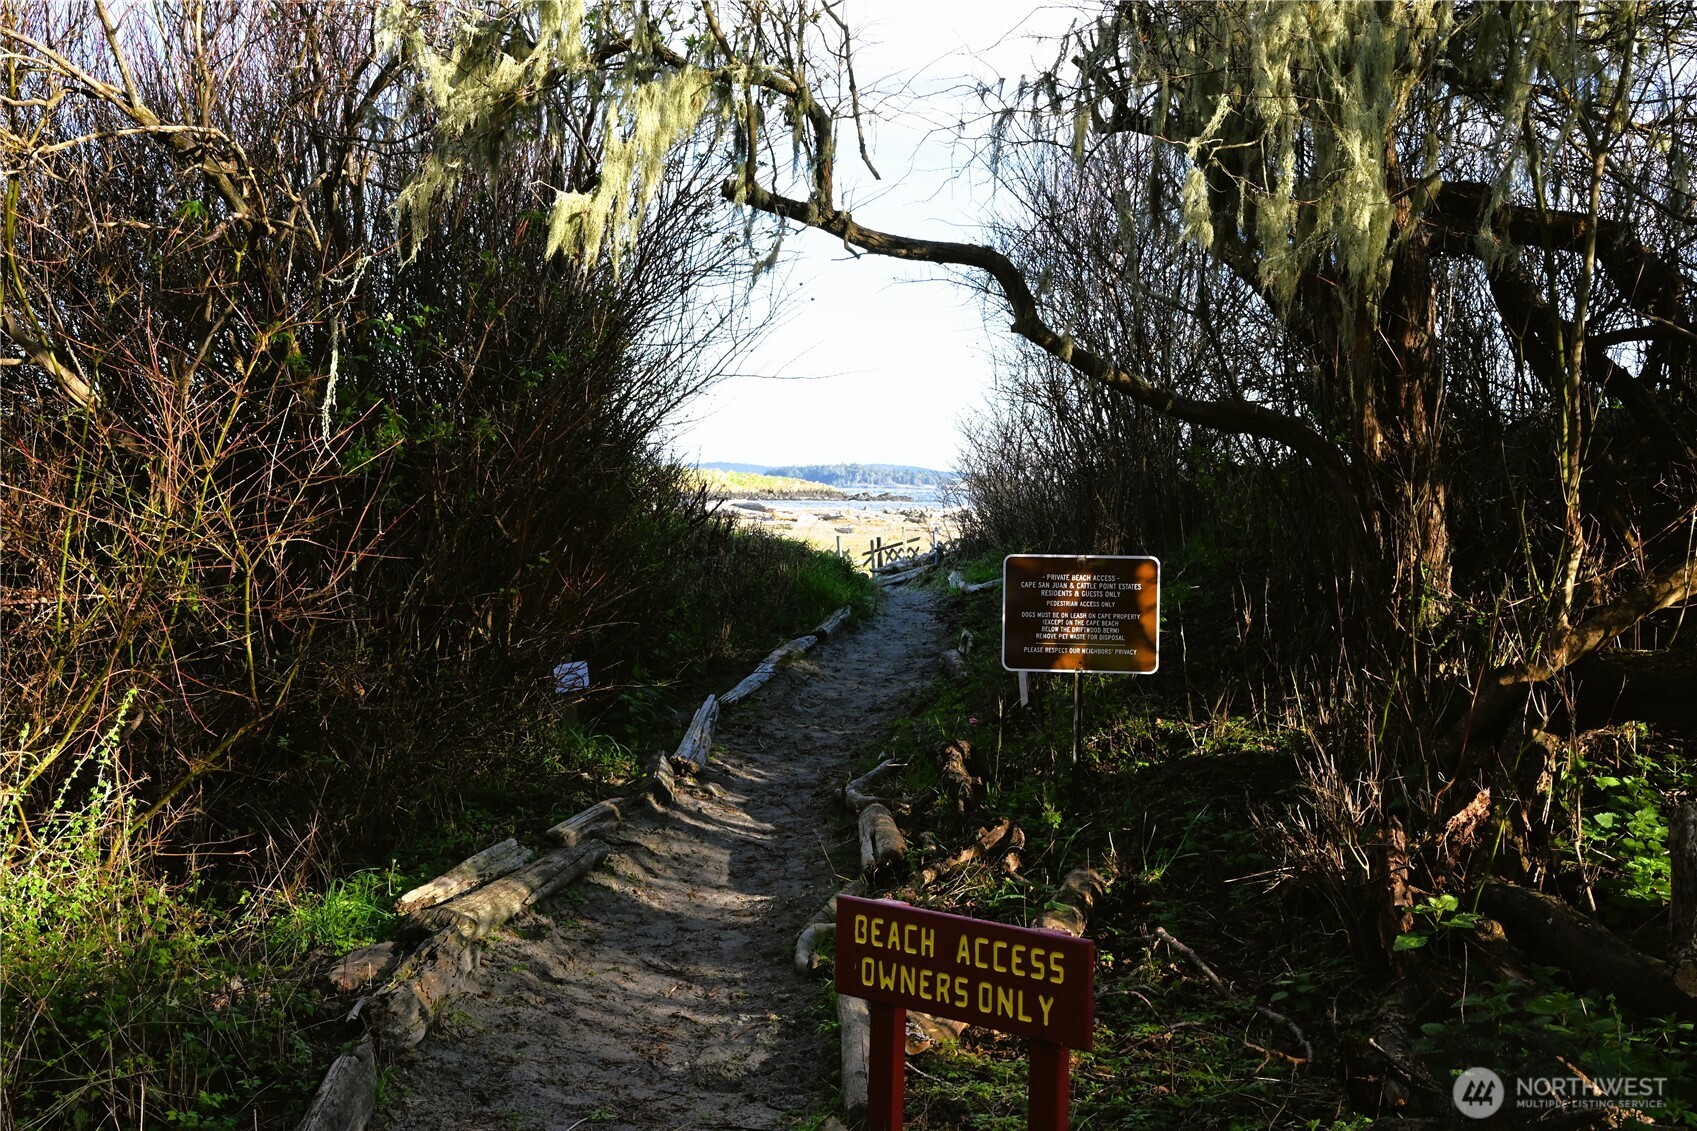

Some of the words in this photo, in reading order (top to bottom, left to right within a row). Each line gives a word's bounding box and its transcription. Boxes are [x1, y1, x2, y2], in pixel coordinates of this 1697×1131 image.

[854, 914, 935, 958] BEACH
[956, 935, 1065, 984] ACCESS
[861, 957, 968, 1008] OWNERS
[978, 981, 1054, 1026] ONLY
